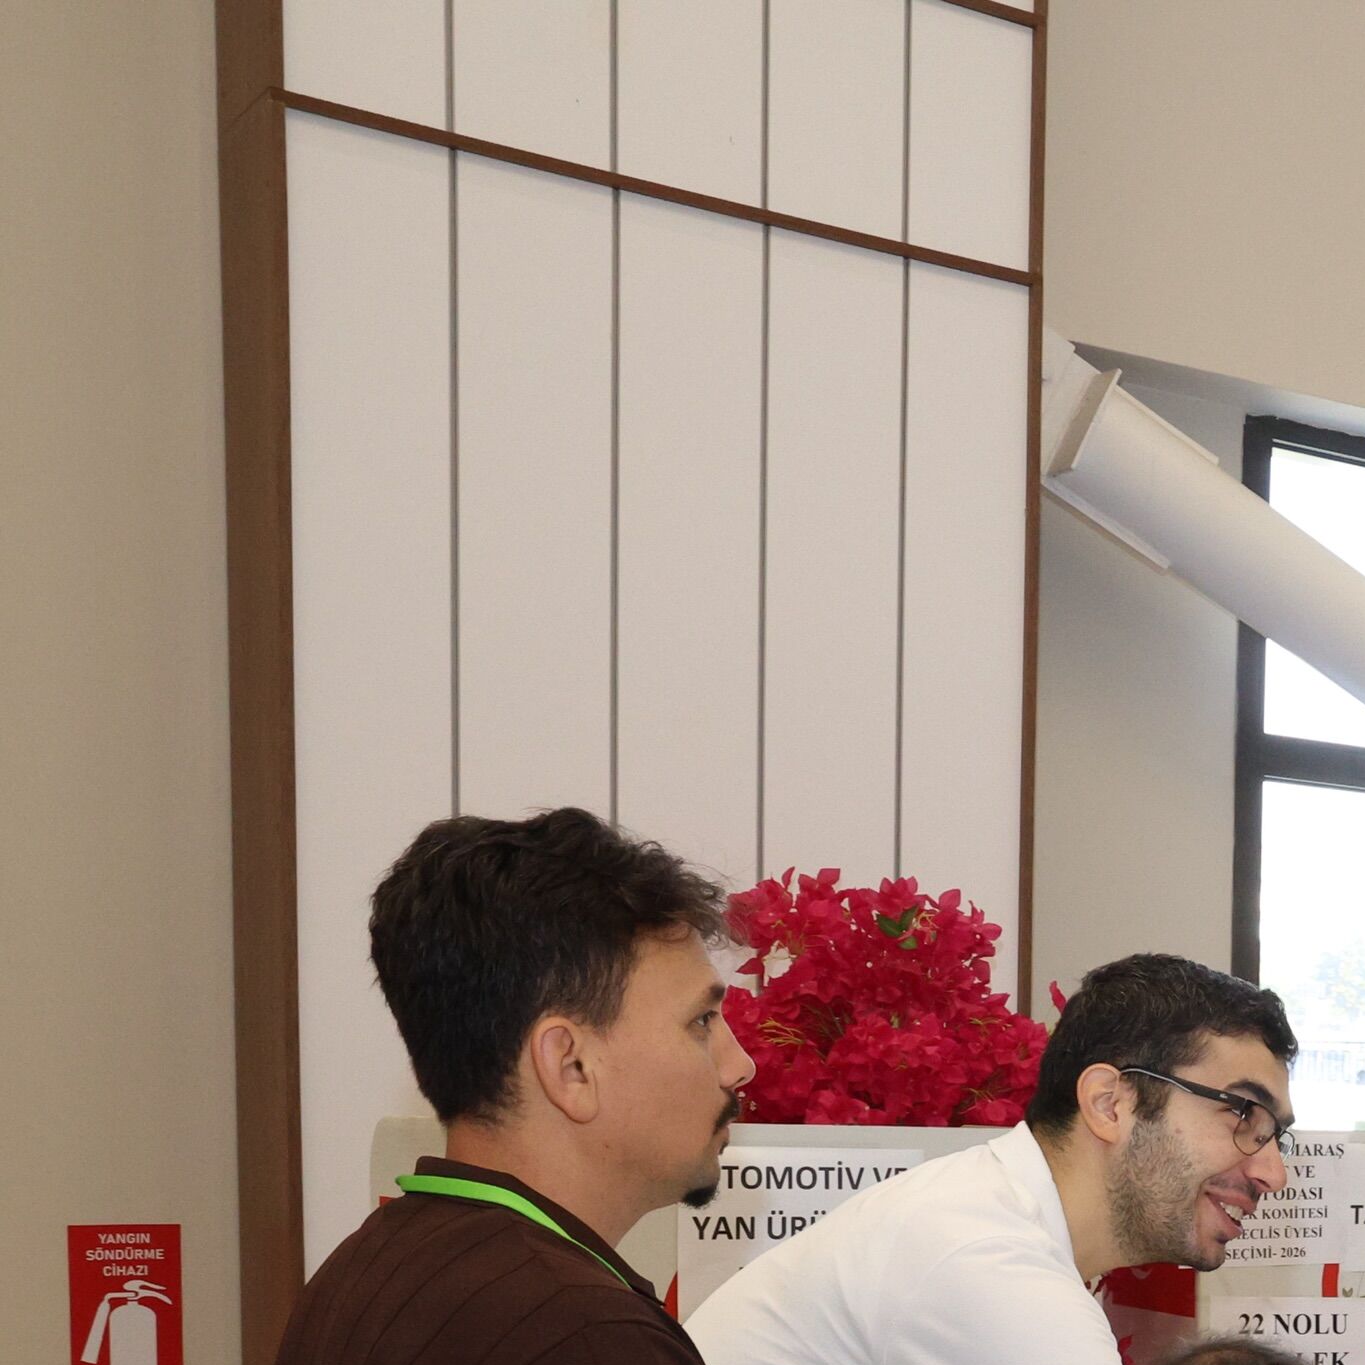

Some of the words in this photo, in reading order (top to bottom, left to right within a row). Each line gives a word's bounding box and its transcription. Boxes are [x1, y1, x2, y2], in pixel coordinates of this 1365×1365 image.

[721, 1160, 865, 1190] TOMOTİV
[1294, 1165, 1316, 1178] VE
[1273, 1187, 1324, 1201] ODASI
[1262, 1205, 1328, 1219] KOMİTESİ
[692, 1216, 755, 1240] YAN
[1238, 1226, 1280, 1240] ECLİS
[1284, 1225, 1323, 1239] ÜYESİ
[98, 1233, 151, 1244] YANGIN
[85, 1246, 165, 1261] SÖNDÜRME
[1280, 1247, 1306, 1258] 2026
[103, 1263, 149, 1277] CİHAZI
[1238, 1313, 1264, 1335] 22
[1272, 1313, 1349, 1335] NOLU
